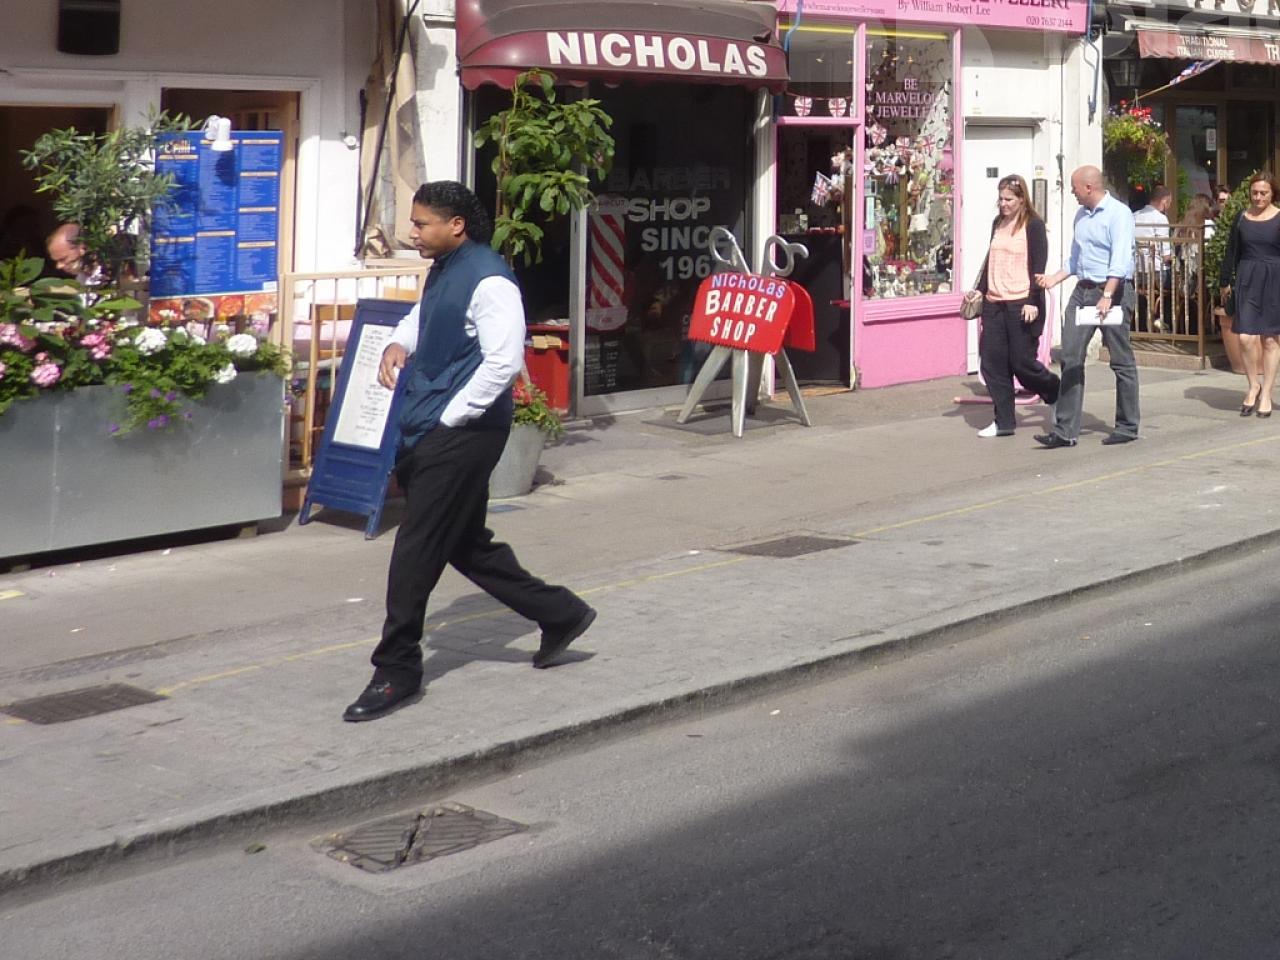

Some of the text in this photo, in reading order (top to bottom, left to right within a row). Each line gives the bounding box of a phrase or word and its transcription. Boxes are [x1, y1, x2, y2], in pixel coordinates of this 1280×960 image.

[898, 0, 909, 12] By
[912, 0, 943, 13] William
[947, 2, 972, 16] Robert
[976, 4, 991, 16] Lee
[546, 31, 768, 77] NICHOLAS
[904, 78, 918, 90] BE
[628, 197, 711, 222] SHOP
[659, 254, 713, 280] 196
[705, 289, 778, 322] BARBER
[710, 316, 756, 344] SHOP
